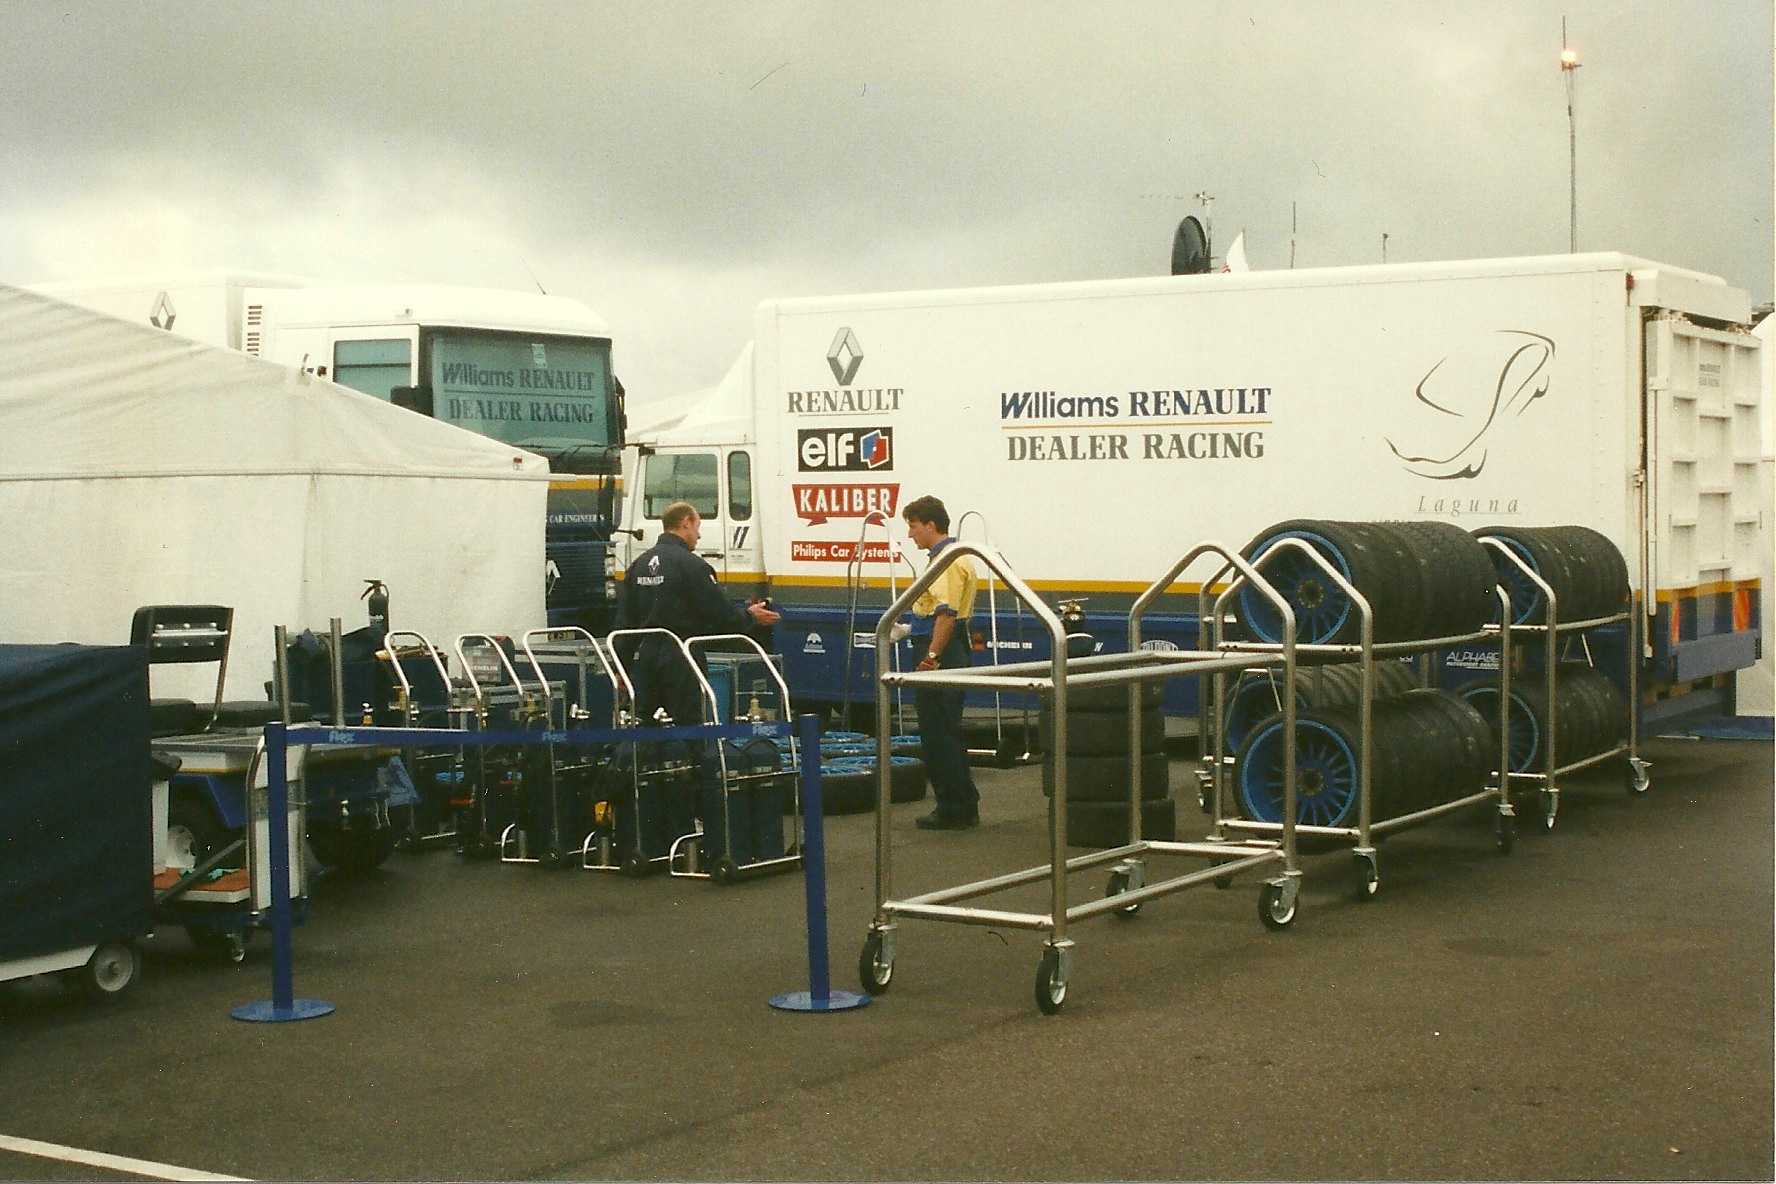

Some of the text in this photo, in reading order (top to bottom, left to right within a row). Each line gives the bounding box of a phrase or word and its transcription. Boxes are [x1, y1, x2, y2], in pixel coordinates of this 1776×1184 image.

[442, 362, 595, 391] Williams RENAULT
[450, 399, 593, 424] DEALER RACING
[787, 388, 904, 413] RENAULT
[1001, 387, 1271, 419] Williams RENAULT
[801, 432, 855, 467] elf
[1007, 431, 1264, 461] DEALER RACING
[800, 487, 891, 513] KALIBER
[1418, 495, 1519, 517] Laguna
[549, 514, 563, 523] CAR
[793, 544, 827, 560] Philips
[830, 545, 850, 558] Car
[1446, 651, 1500, 662] ALPHABE
